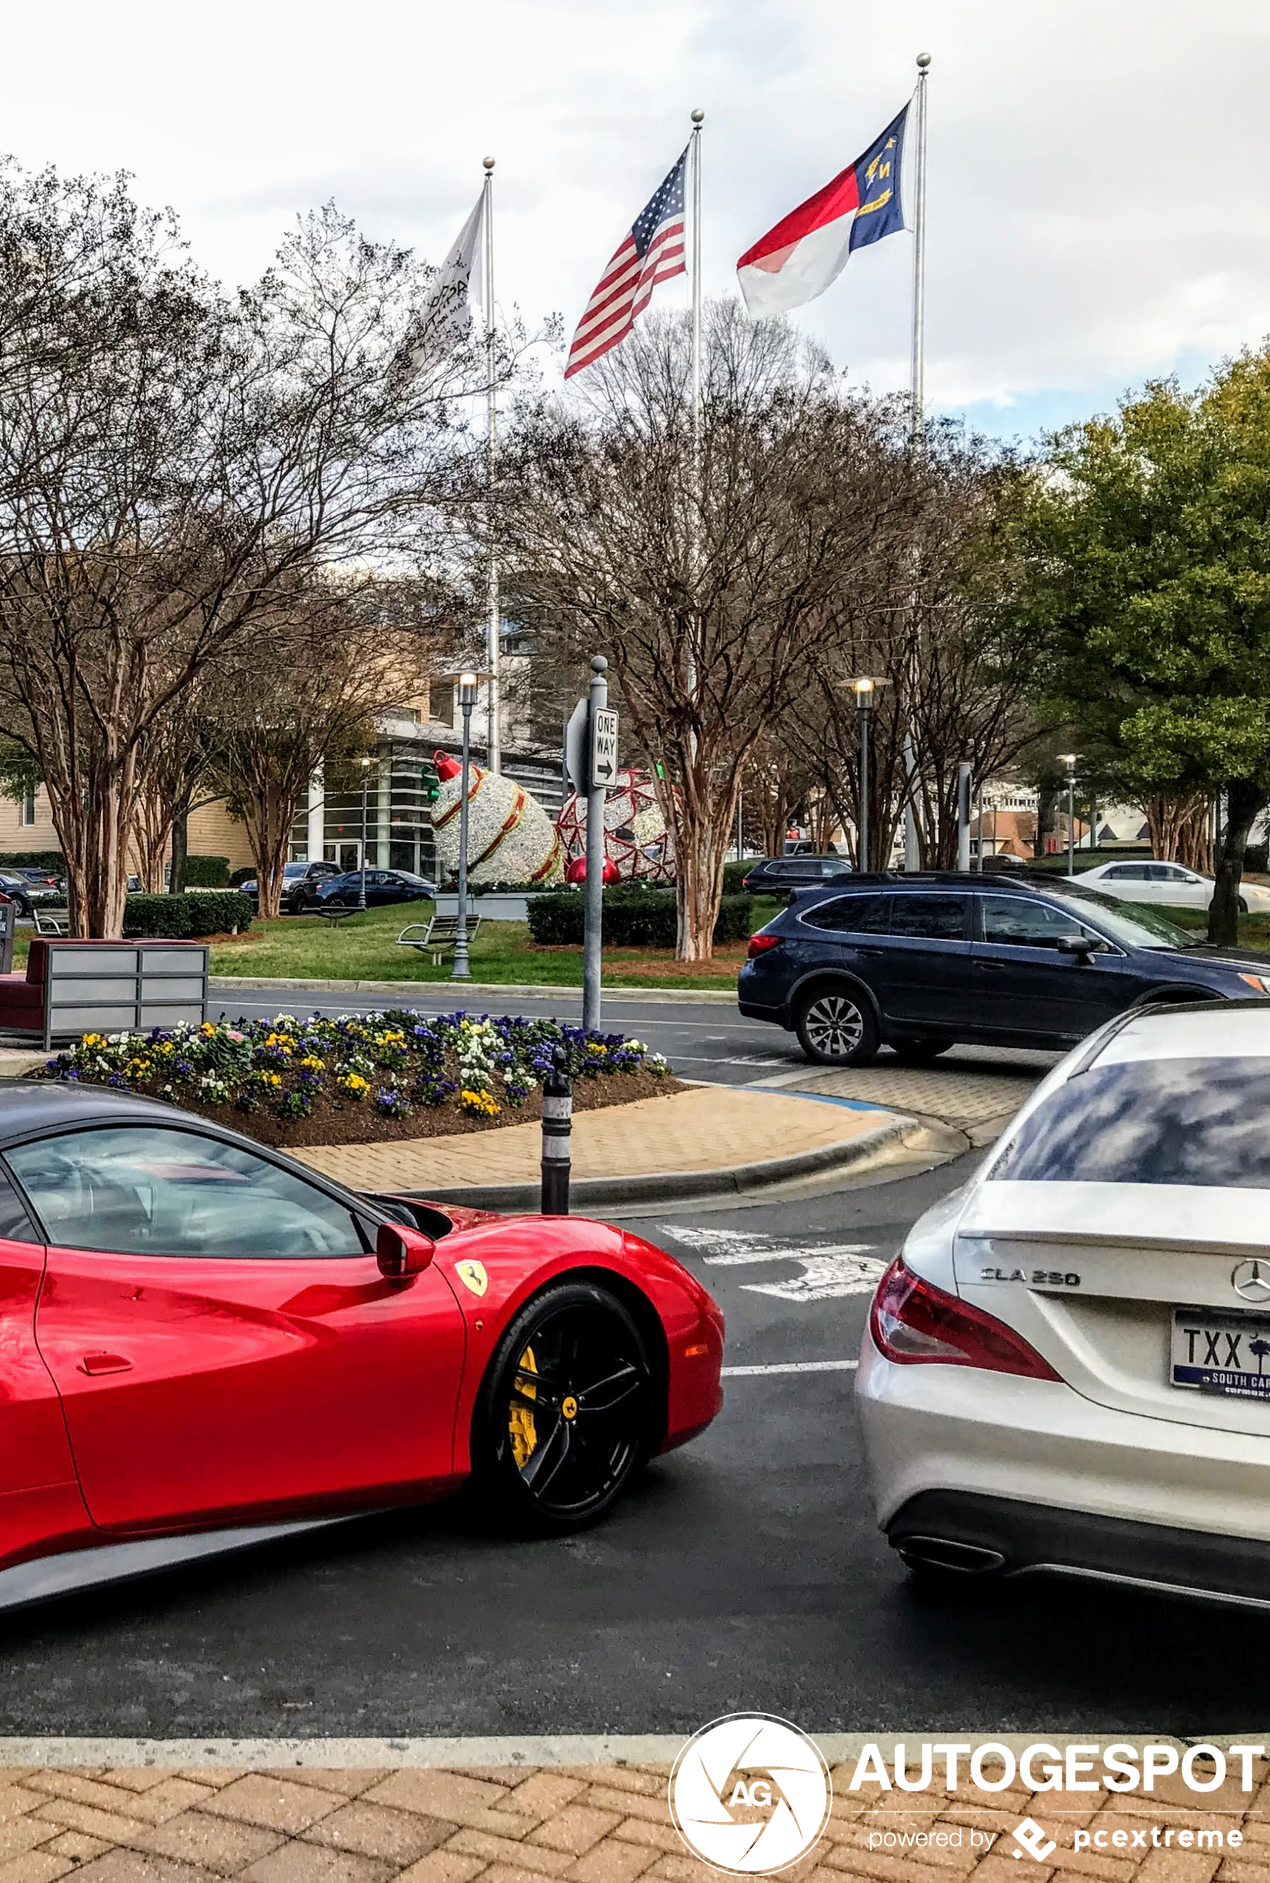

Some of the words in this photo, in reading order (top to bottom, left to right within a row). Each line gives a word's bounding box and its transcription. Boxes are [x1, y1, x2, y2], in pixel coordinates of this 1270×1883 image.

[597, 714, 616, 735] ONE
[596, 736, 616, 757] WAY
[980, 1267, 1027, 1283] CLA
[1032, 1269, 1082, 1287] 250
[1183, 1328, 1242, 1369] TXX
[1212, 1372, 1248, 1387] SOUTH
